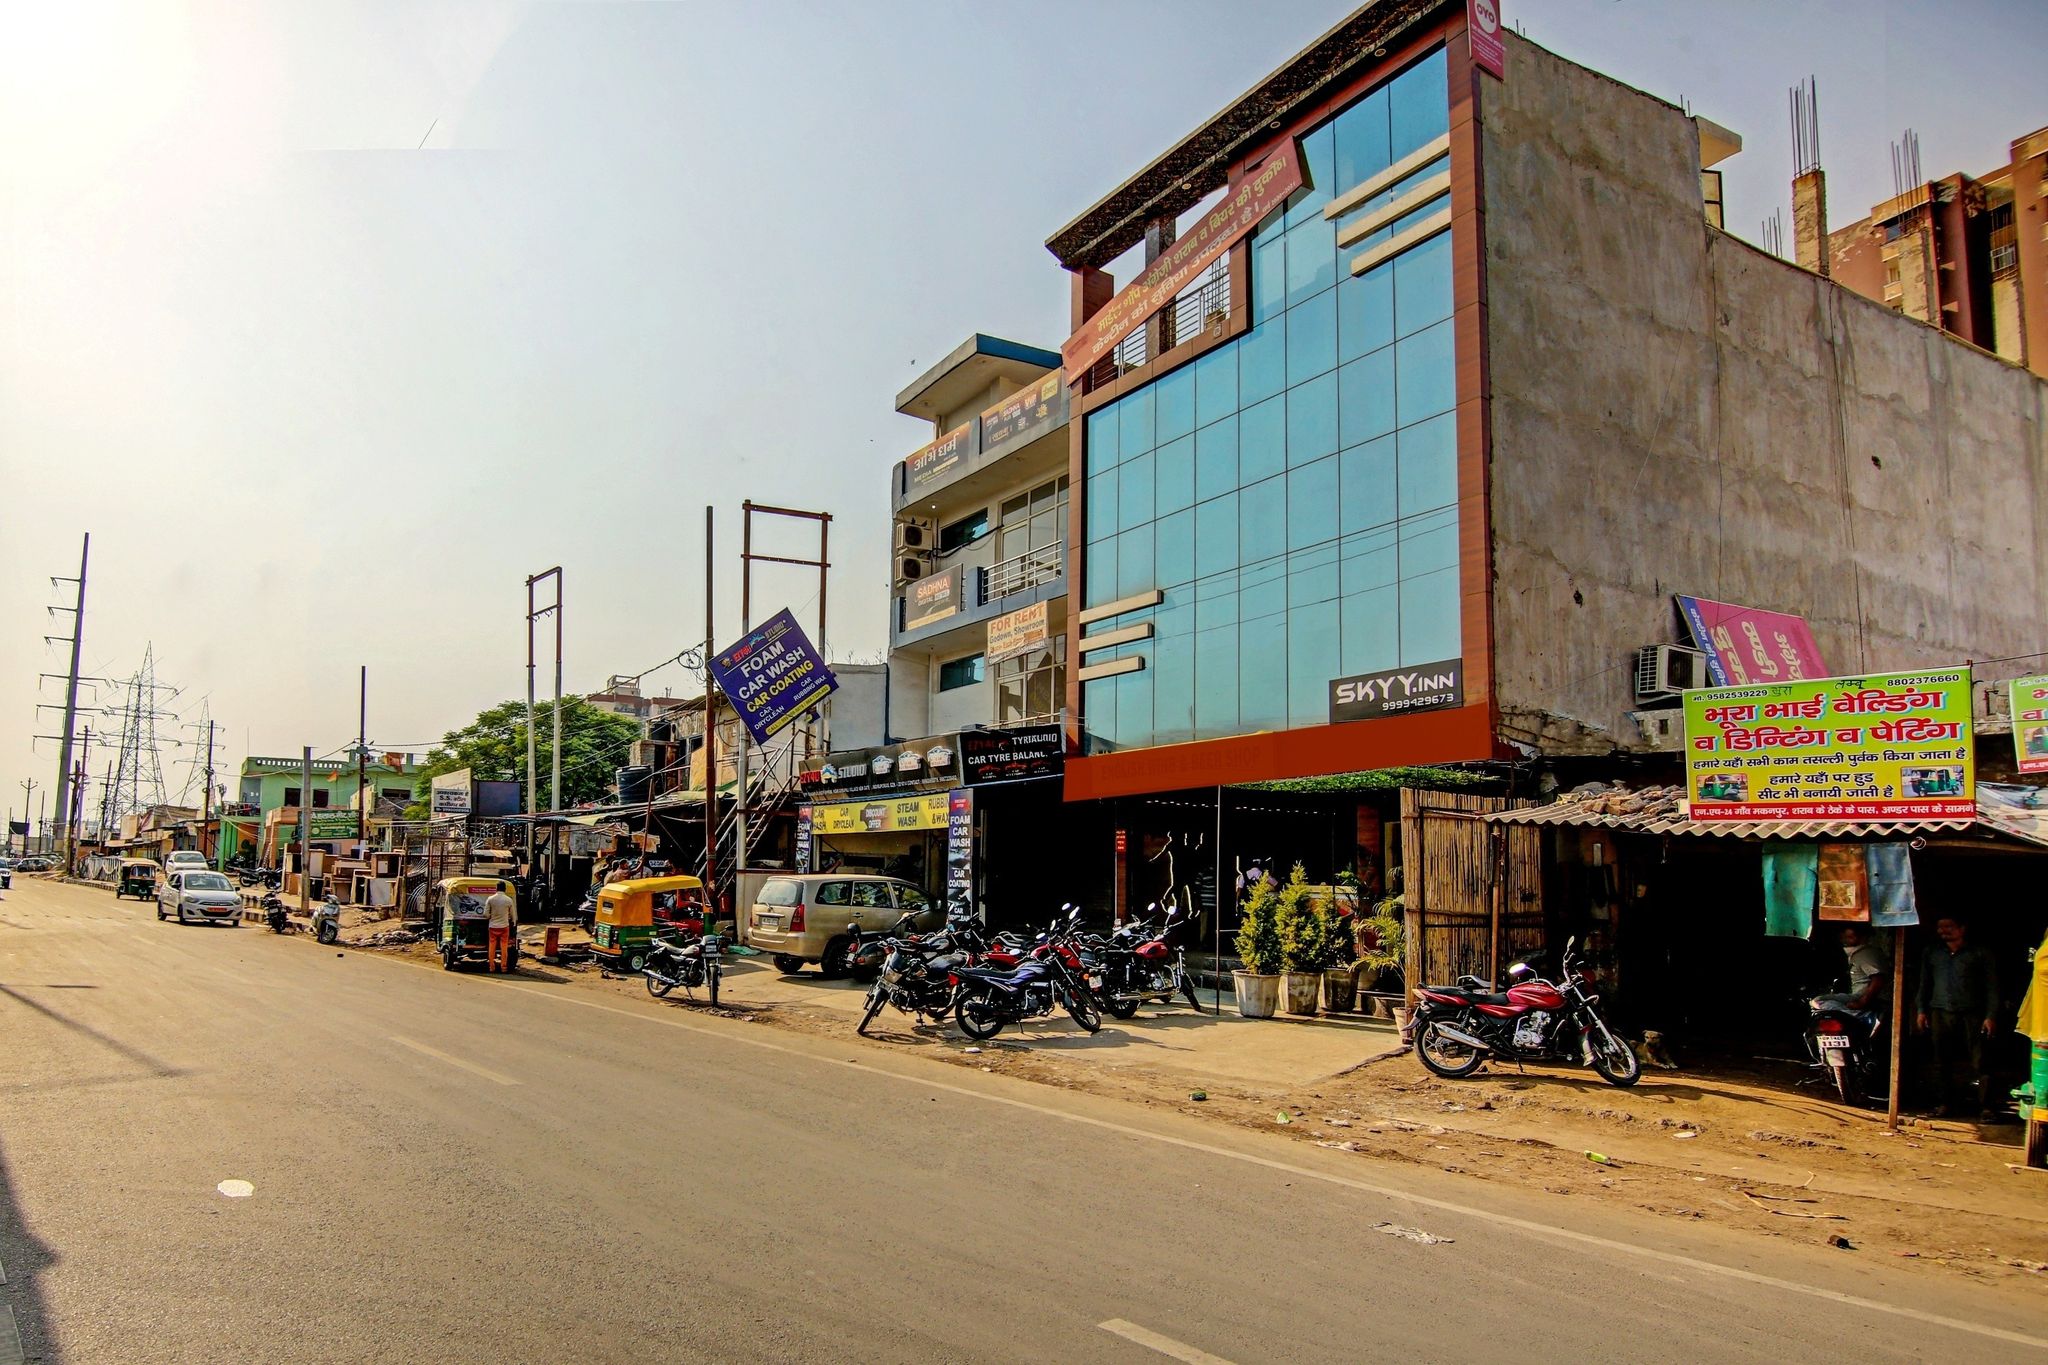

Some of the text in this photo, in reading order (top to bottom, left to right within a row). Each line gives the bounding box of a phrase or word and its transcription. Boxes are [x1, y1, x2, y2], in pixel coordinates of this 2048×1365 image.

[1476, 3, 1495, 24] OYO
[917, 577, 950, 599] SADHNA
[990, 603, 1045, 635] FOR RENT
[740, 640, 785, 678] FOAM
[738, 646, 806, 699] CAR WASH
[746, 691, 771, 713] CAR
[769, 660, 814, 696] COATING
[801, 676, 812, 688] CAR
[1887, 674, 1960, 687] 8802376660
[793, 674, 828, 702] RUBBING WAX
[1707, 689, 1768, 701] 9582539229
[1382, 693, 1454, 711] 9999429673
[1704, 687, 1944, 729] भूरा भाई वेल्डिंग
[754, 705, 785, 730] DRYCLEAN
[759, 706, 773, 718] CAR
[1693, 736, 1717, 751] व
[1722, 725, 1828, 750] डिन्टिंग
[1835, 728, 1862, 744] व
[968, 755, 987, 766] CAR
[988, 753, 1011, 763] TYRE
[1693, 758, 1720, 769] हमारे
[1723, 756, 1743, 768] यहाँ
[1746, 755, 1770, 767] सभी
[1773, 757, 1799, 766] काम
[1803, 752, 1844, 765] तसल्ली
[1883, 750, 1915, 761] किया
[1919, 750, 1951, 760] जाता
[1955, 746, 1967, 760] है
[1769, 770, 1875, 787] हमारे यहाँ पर हुड
[1758, 787, 1781, 800] सीट
[1784, 787, 1799, 799] भी
[1846, 785, 1879, 798] जाती
[1883, 785, 1895, 798] है
[839, 807, 849, 817] CAR
[896, 801, 920, 814] STEAM
[1792, 807, 1814, 815] शराब
[1815, 804, 1826, 815] के
[1844, 804, 1855, 815] के
[1881, 805, 1909, 815] अण्डर
[1910, 805, 1929, 814] पास
[1931, 803, 1942, 814] के
[1945, 802, 1974, 814] सामने
[868, 818, 882, 829] OFFER
[897, 815, 918, 827] WASH
[950, 815, 971, 825] FOAM
[952, 827, 969, 836] CAR
[949, 838, 971, 848] WASH
[953, 870, 966, 878] CAR
[948, 880, 971, 888] COATING
